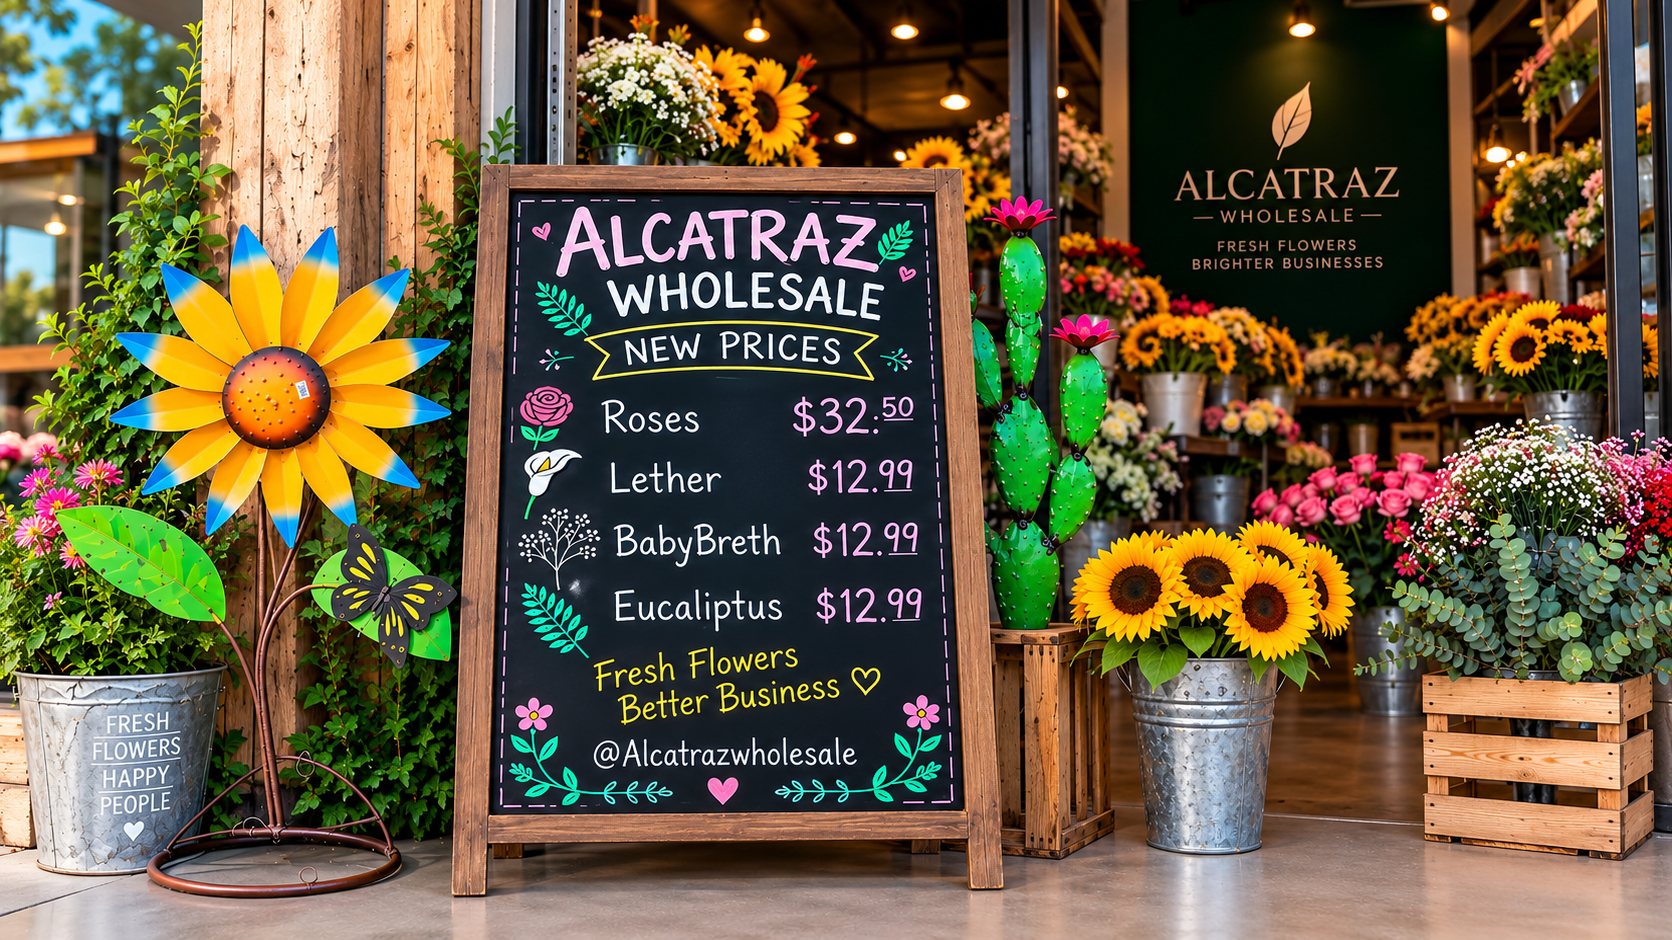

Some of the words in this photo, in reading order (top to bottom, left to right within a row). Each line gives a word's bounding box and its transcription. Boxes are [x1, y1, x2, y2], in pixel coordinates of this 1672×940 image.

[1174, 166, 1400, 201] ALCATRAZ
[1220, 208, 1354, 224] WHOLESALE
[556, 206, 879, 277] ALCATRAZ
[1217, 240, 1269, 252] FRESH
[1278, 239, 1357, 252] FLOWERS
[1192, 257, 1274, 270] BRIGHTER
[1282, 256, 1384, 269] BUSINESSES
[607, 271, 885, 320] WHOLESALE
[624, 333, 701, 366] NEW
[719, 331, 841, 365] PRICES
[601, 400, 699, 433] Roses
[611, 461, 721, 493] Lether
[808, 459, 912, 495] $12.99
[614, 524, 781, 567] BabyBreth
[814, 522, 918, 558] $12.99
[615, 589, 782, 631] Eucaliptus
[817, 587, 921, 624] $12.99
[593, 652, 675, 692] Fresh
[688, 647, 798, 678] Flowers
[618, 691, 708, 725] Better
[716, 676, 840, 713] Business
[105, 711, 170, 735] FRESH
[92, 736, 181, 761] FLOWERS
[594, 737, 857, 769] @Alcatrazwholesale
[102, 764, 171, 789] HAPPY
[100, 791, 171, 816] PEOPLE
